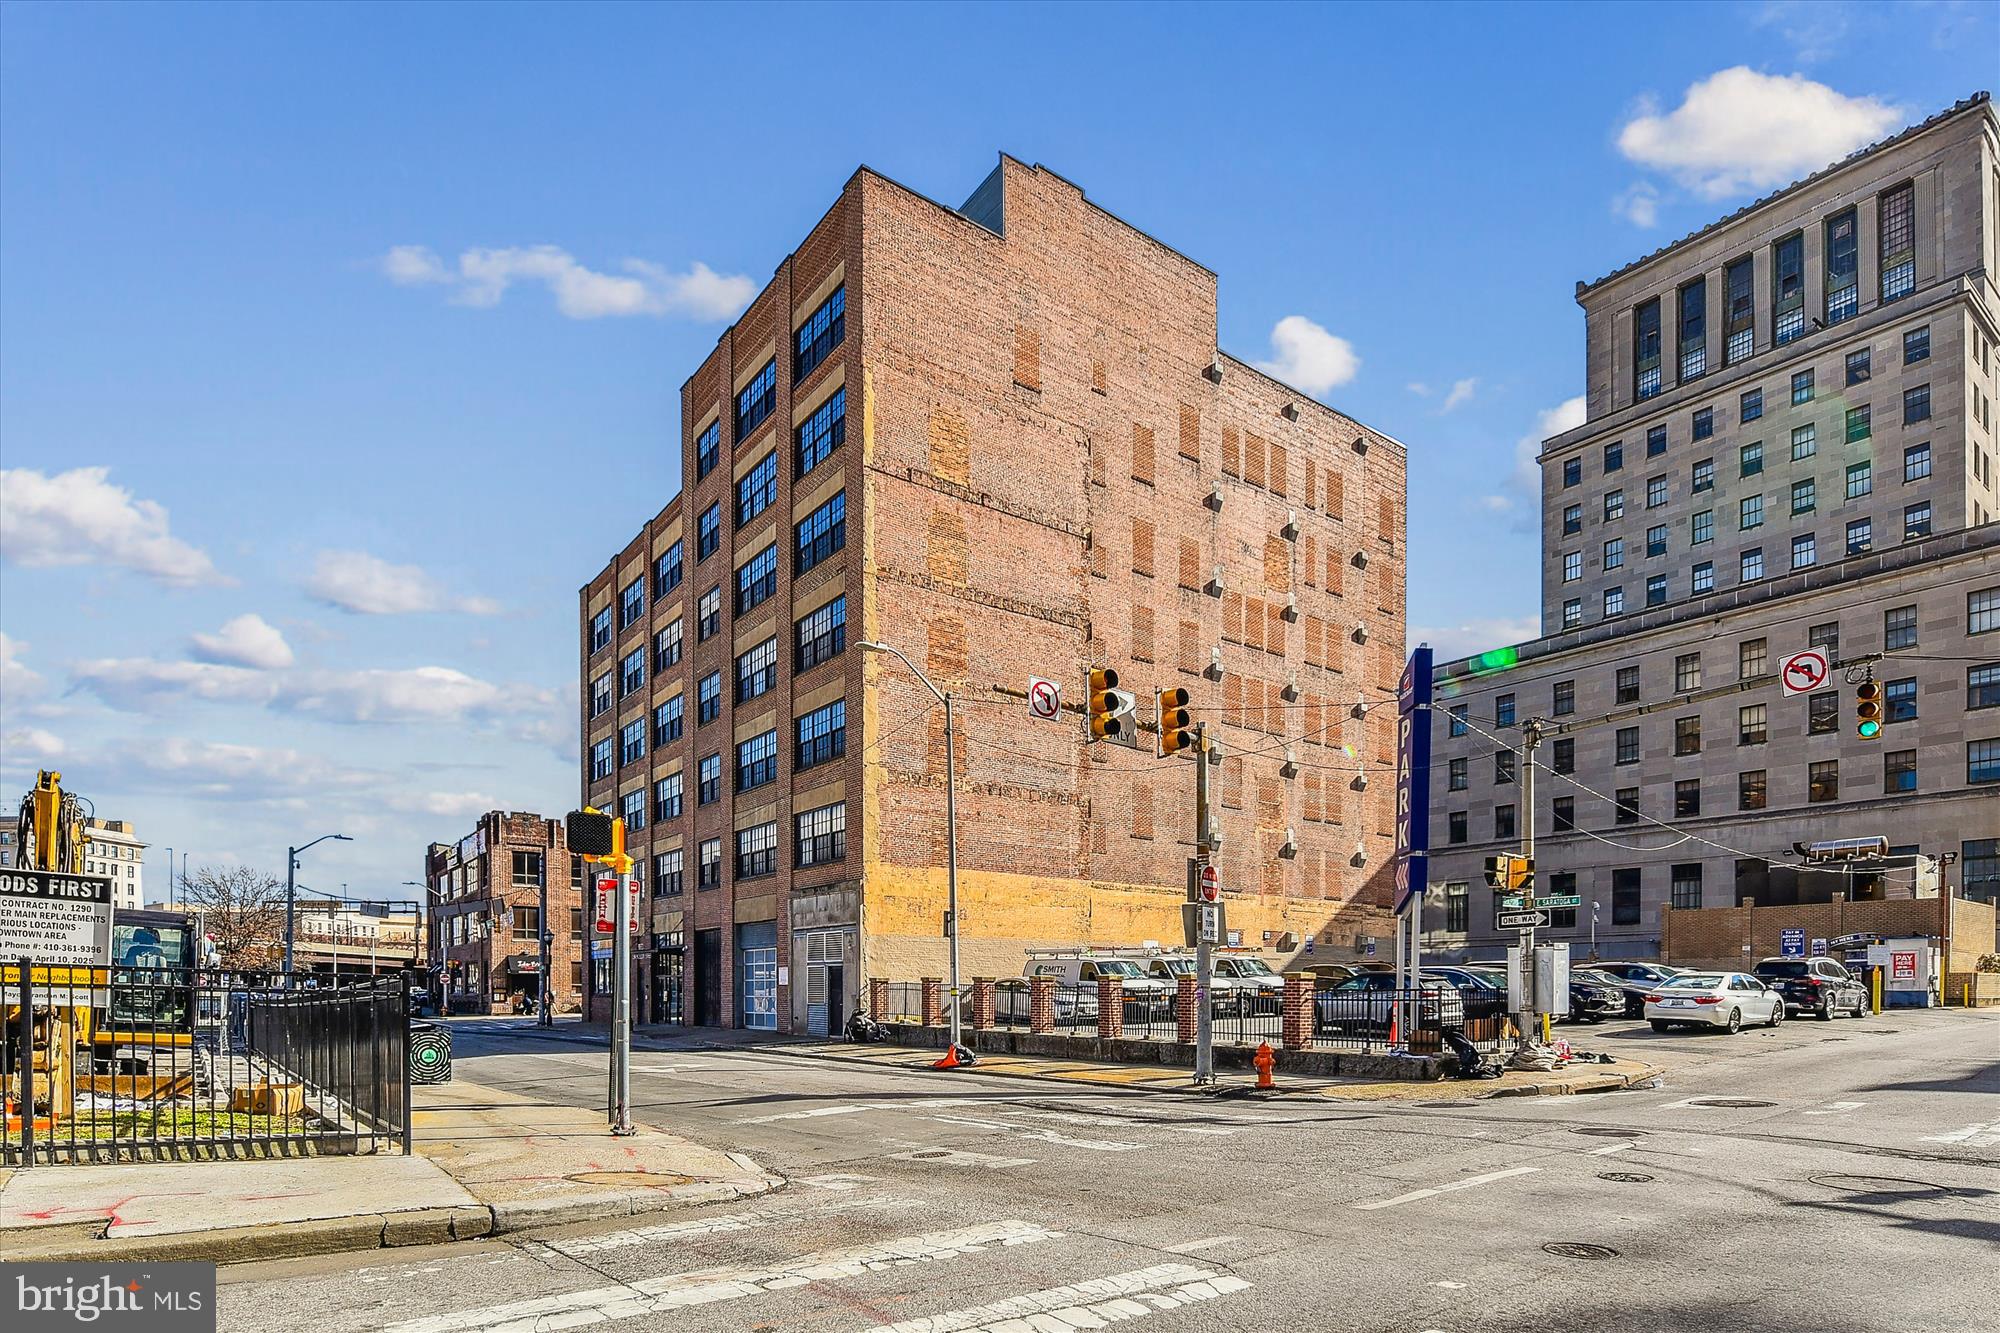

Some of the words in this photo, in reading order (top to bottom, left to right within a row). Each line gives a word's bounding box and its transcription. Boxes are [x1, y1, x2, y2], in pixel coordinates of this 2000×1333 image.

[1399, 719, 1411, 849] PARK
[49, 879, 104, 898] FIRST
[2, 899, 49, 910] CONTRACT
[51, 903, 67, 911] NO.
[71, 904, 92, 913] 1290
[1542, 898, 1571, 906] SARATOGA
[14, 910, 37, 919] MAIN
[39, 912, 106, 924] REPLACEMENTS
[1521, 915, 1538, 923] WAY
[30, 921, 76, 931] LOCATIONS
[43, 932, 67, 940] AREA
[5, 941, 31, 950] Phone
[43, 943, 102, 954] 410-361-9396
[35, 955, 55, 964] April
[57, 956, 70, 964] 10,
[72, 957, 94, 965] 2025
[1043, 965, 1066, 973] SMITH
